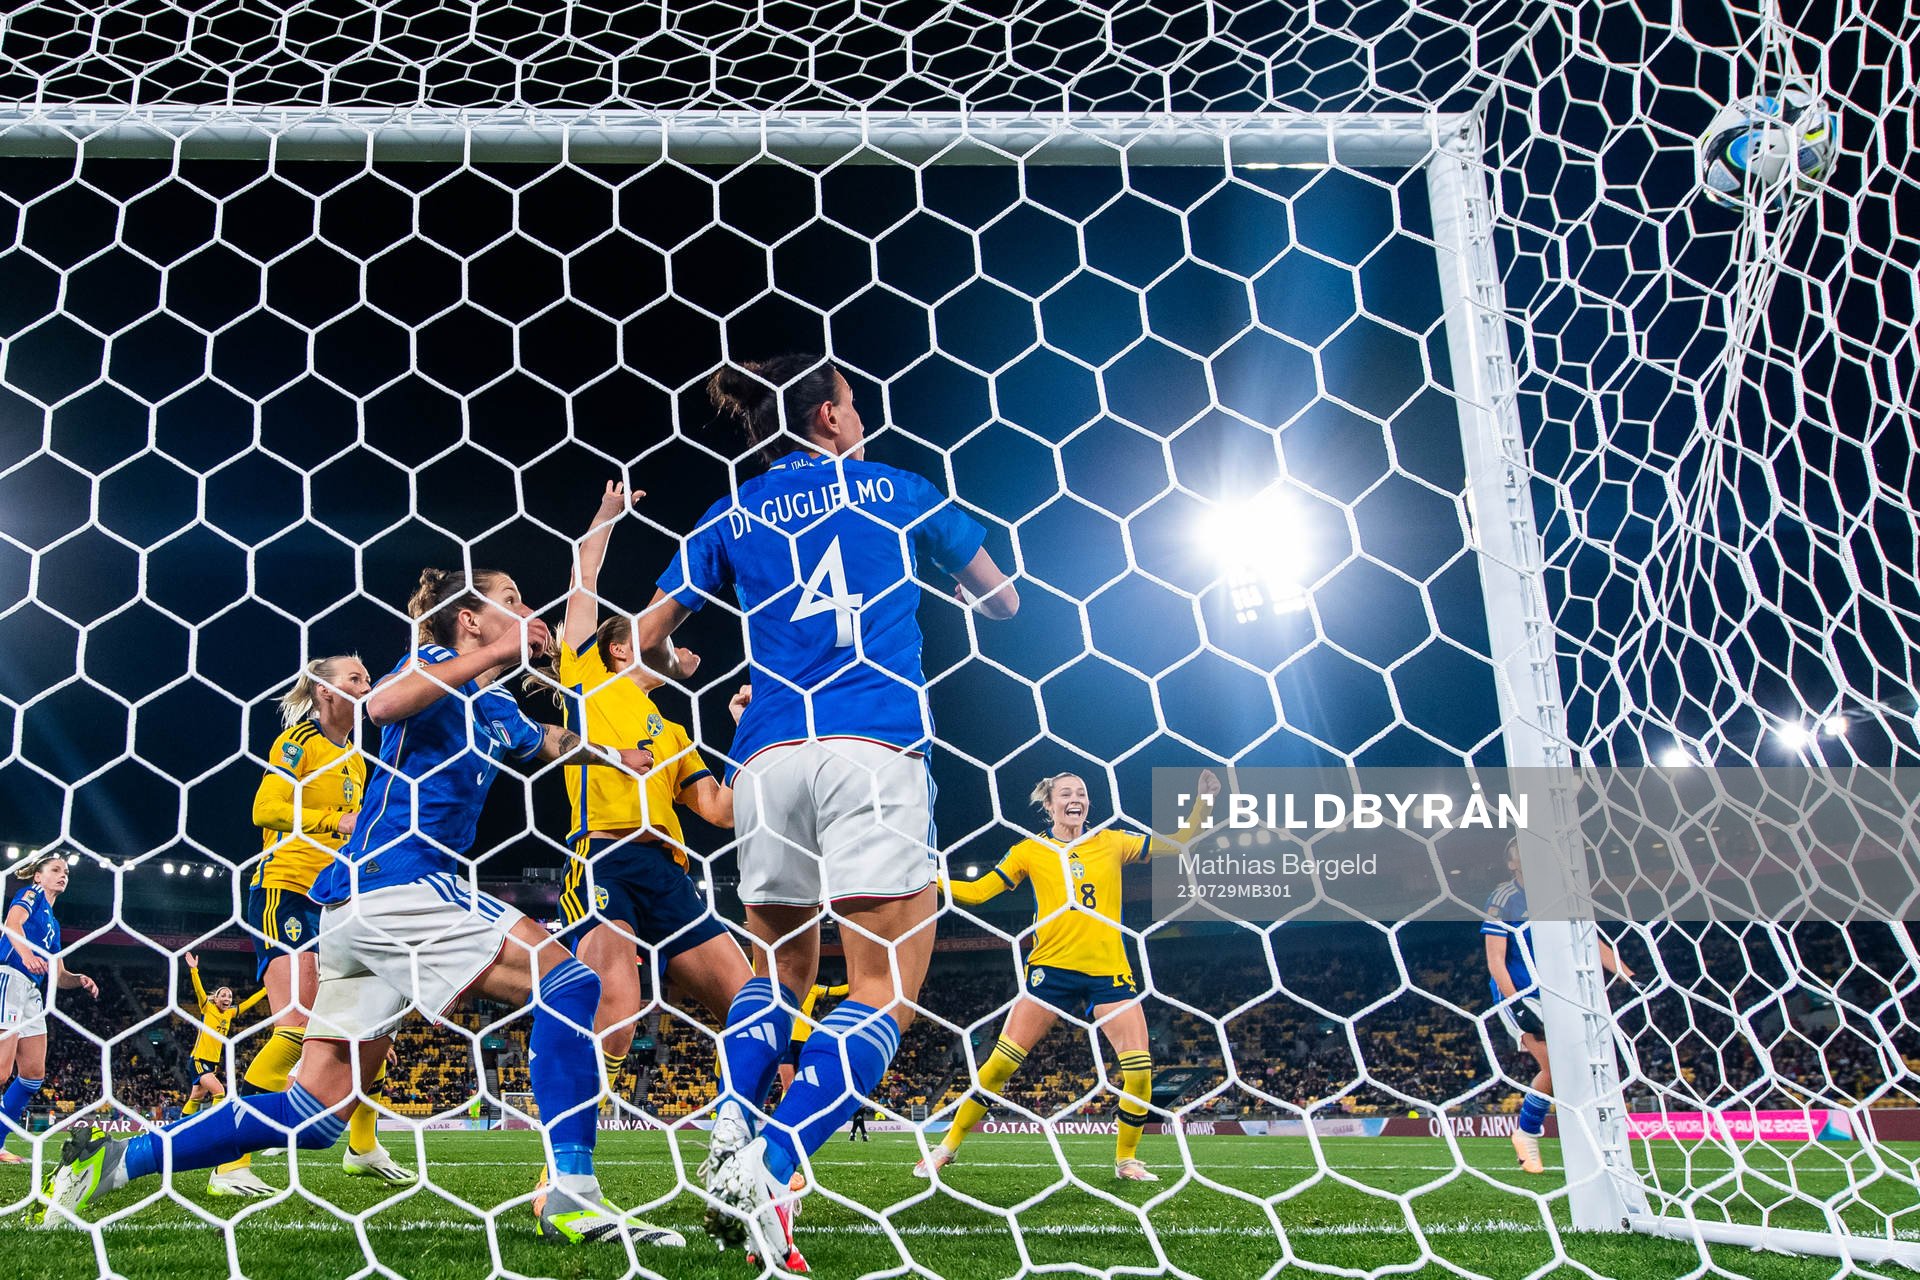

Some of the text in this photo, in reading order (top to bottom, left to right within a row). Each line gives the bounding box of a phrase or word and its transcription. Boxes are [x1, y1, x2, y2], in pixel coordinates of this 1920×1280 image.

[729, 509, 752, 540] DI
[789, 534, 864, 648] 4
[983, 1122, 1041, 1134] QATAR
